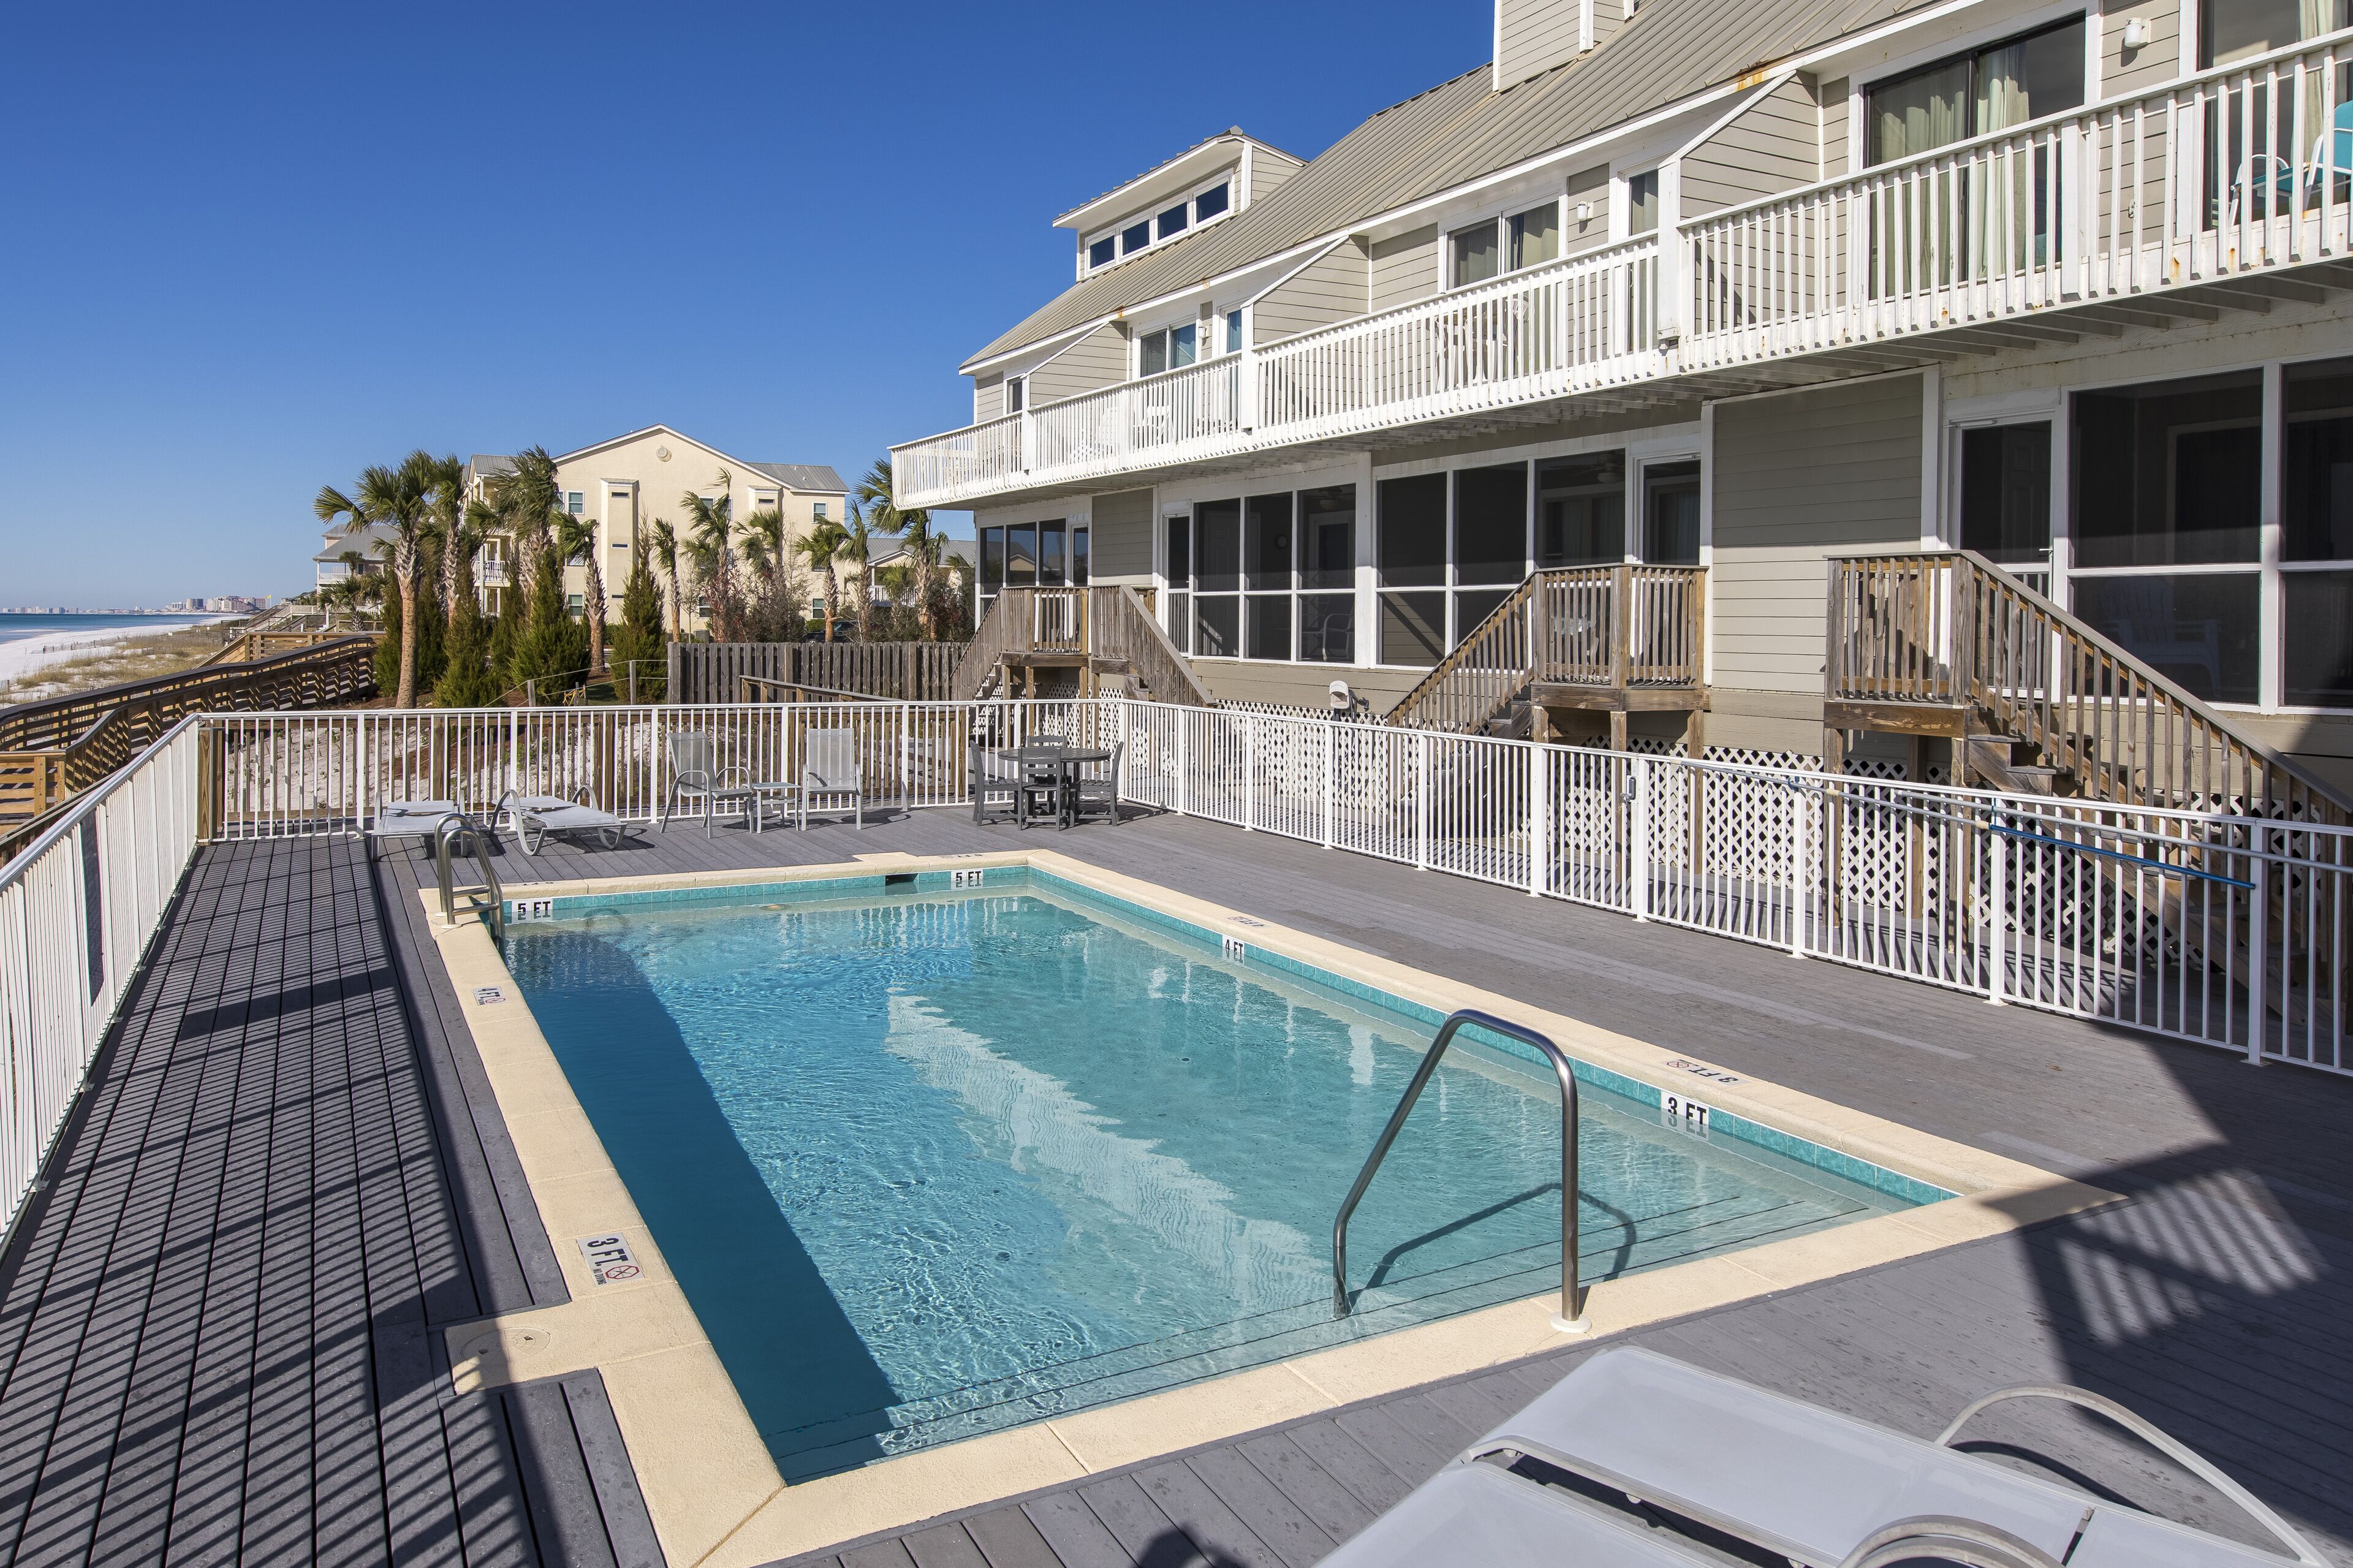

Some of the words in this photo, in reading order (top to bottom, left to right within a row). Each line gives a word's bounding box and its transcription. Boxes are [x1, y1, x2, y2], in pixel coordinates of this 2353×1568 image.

[956, 872, 962, 881] 5
[968, 871, 981, 881] FT
[518, 903, 526, 912] 5
[533, 901, 551, 912] FT
[1225, 939, 1230, 950] 4
[1233, 941, 1243, 955] FT
[1667, 1096, 1678, 1115] 3
[587, 1237, 619, 1248] 3
[591, 1248, 629, 1267] FT.
